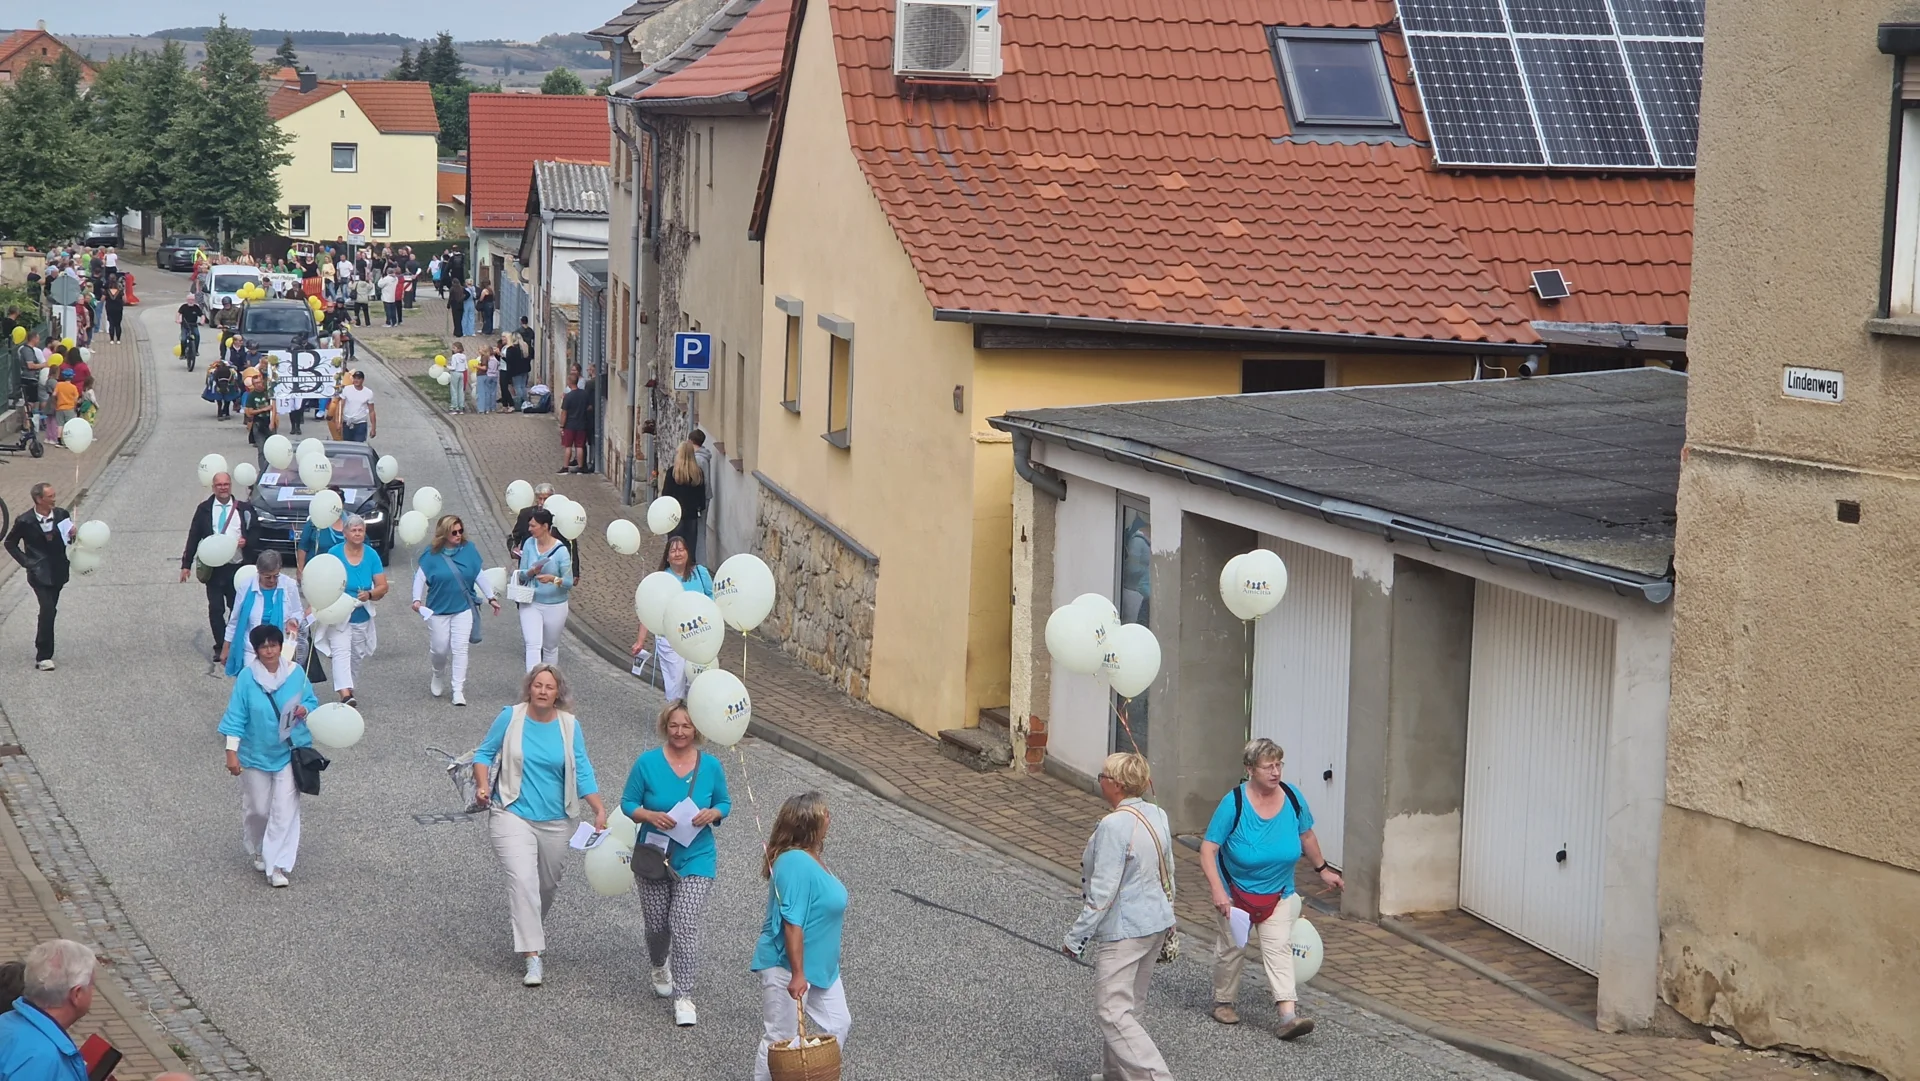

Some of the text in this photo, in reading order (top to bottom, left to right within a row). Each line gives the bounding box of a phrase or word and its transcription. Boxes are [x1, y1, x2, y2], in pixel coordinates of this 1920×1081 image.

[683, 337, 702, 365] P
[285, 349, 324, 394] B
[1788, 370, 1838, 399] Lindenweg
[279, 398, 290, 408] 15
[1242, 587, 1271, 596] Amicitia
[680, 623, 712, 642] Amicitia
